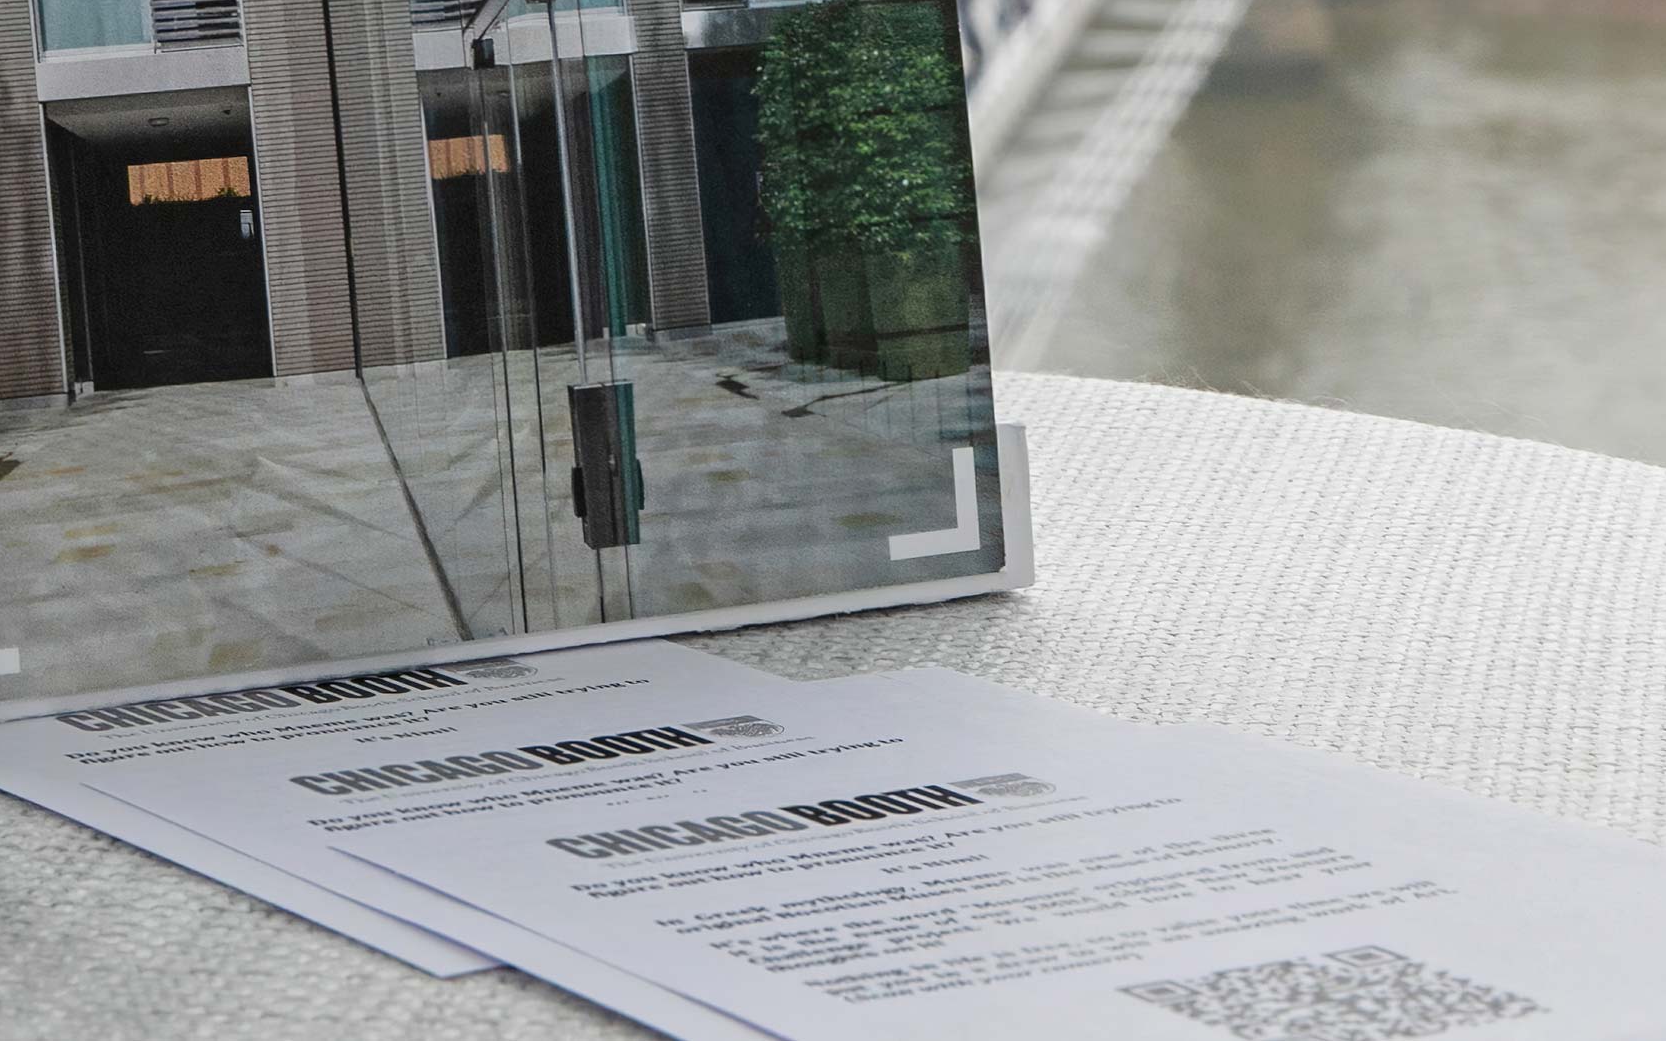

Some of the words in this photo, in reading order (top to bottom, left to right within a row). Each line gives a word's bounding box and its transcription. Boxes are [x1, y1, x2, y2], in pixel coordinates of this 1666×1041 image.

[56, 691, 302, 732] CHICAGO
[279, 669, 469, 705] BOOTH
[289, 750, 544, 795] CHICAGO
[517, 726, 715, 765] BOOTH
[545, 810, 809, 859] CHICAGO
[775, 784, 985, 826] BOOTH
